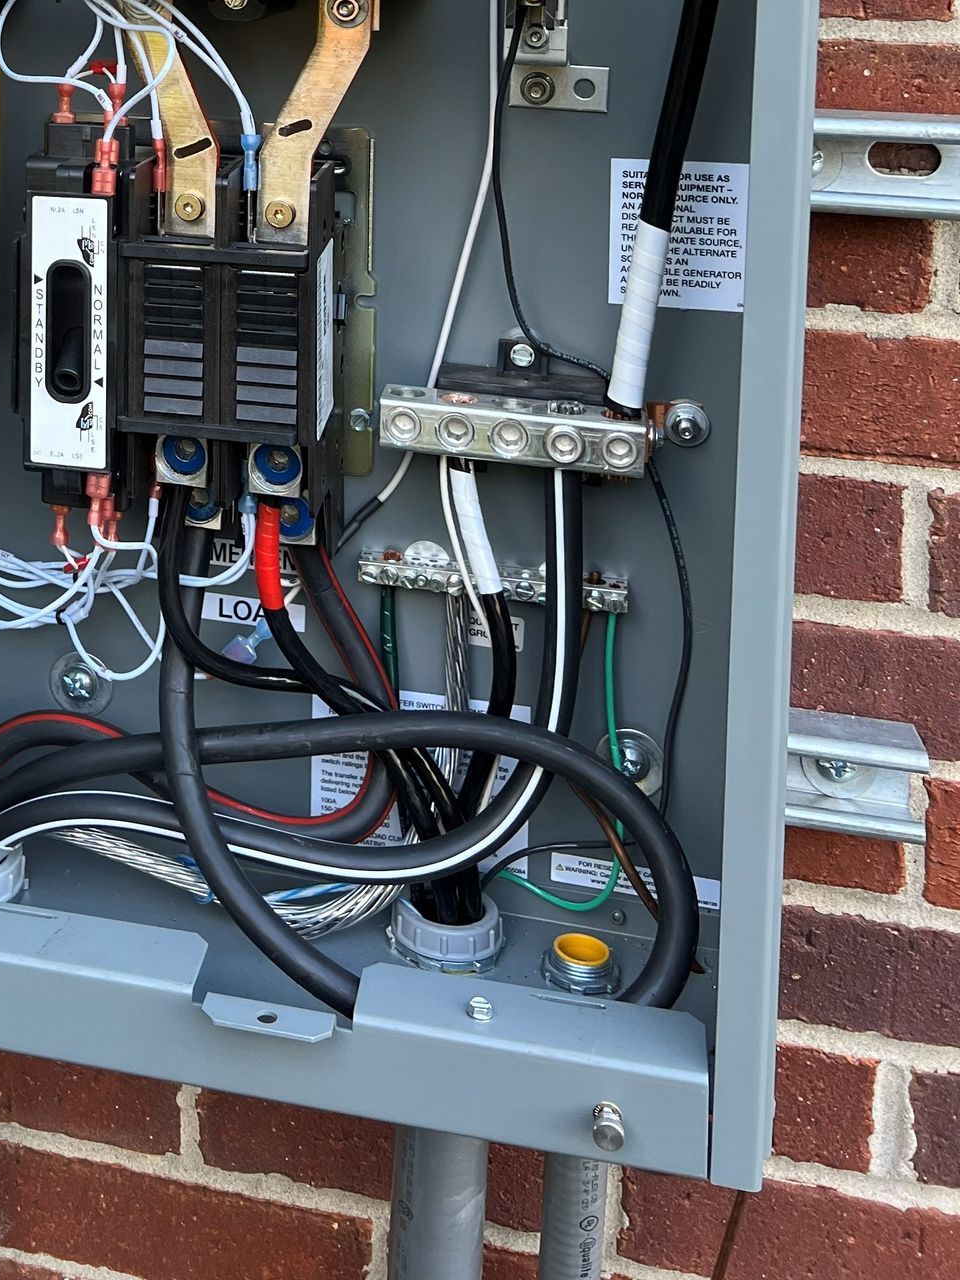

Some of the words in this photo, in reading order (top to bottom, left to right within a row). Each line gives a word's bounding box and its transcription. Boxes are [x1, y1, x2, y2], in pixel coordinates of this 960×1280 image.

[694, 174, 714, 182] USE
[716, 174, 730, 183] AS
[710, 195, 739, 205] ONLY.
[621, 202, 636, 210] AN
[686, 216, 715, 225] MUST
[717, 218, 731, 226] BE
[716, 227, 738, 237] FOR
[698, 239, 743, 249] SOURCE,
[682, 248, 738, 259] ALTERNATE
[682, 269, 743, 280] GENERATOR
[666, 279, 680, 287] BE
[681, 280, 722, 289] READILY
[92, 284, 103, 370] NORMAL
[34, 288, 44, 388] STANDBY
[321, 758, 340, 766] switch
[342, 760, 363, 769] ratings
[321, 769, 333, 777] The
[334, 771, 358, 780] transfer
[320, 778, 351, 788] delivering
[578, 860, 593, 868] FOR
